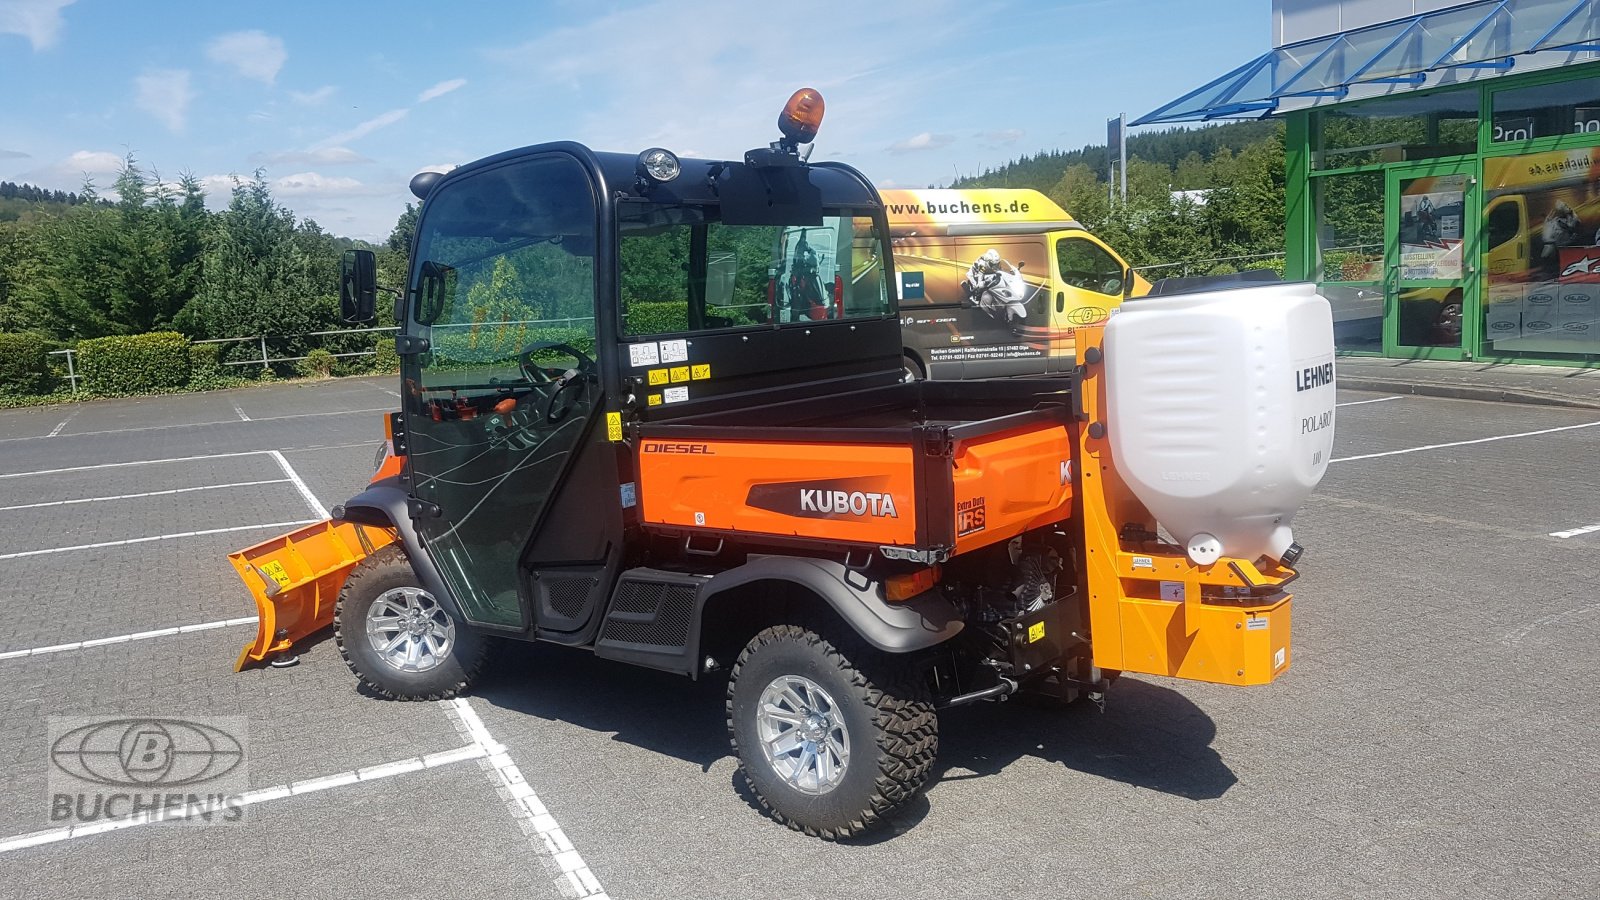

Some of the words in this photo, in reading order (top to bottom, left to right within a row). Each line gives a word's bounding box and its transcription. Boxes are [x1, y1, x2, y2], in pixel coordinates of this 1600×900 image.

[884, 200, 1030, 215] ww.buchens.de
[1296, 362, 1334, 392] LEHNER
[644, 443, 715, 454] DIESEL
[1162, 471, 1212, 482] LEHNER
[800, 488, 898, 518] KUBOTA
[957, 500, 972, 511] Extra
